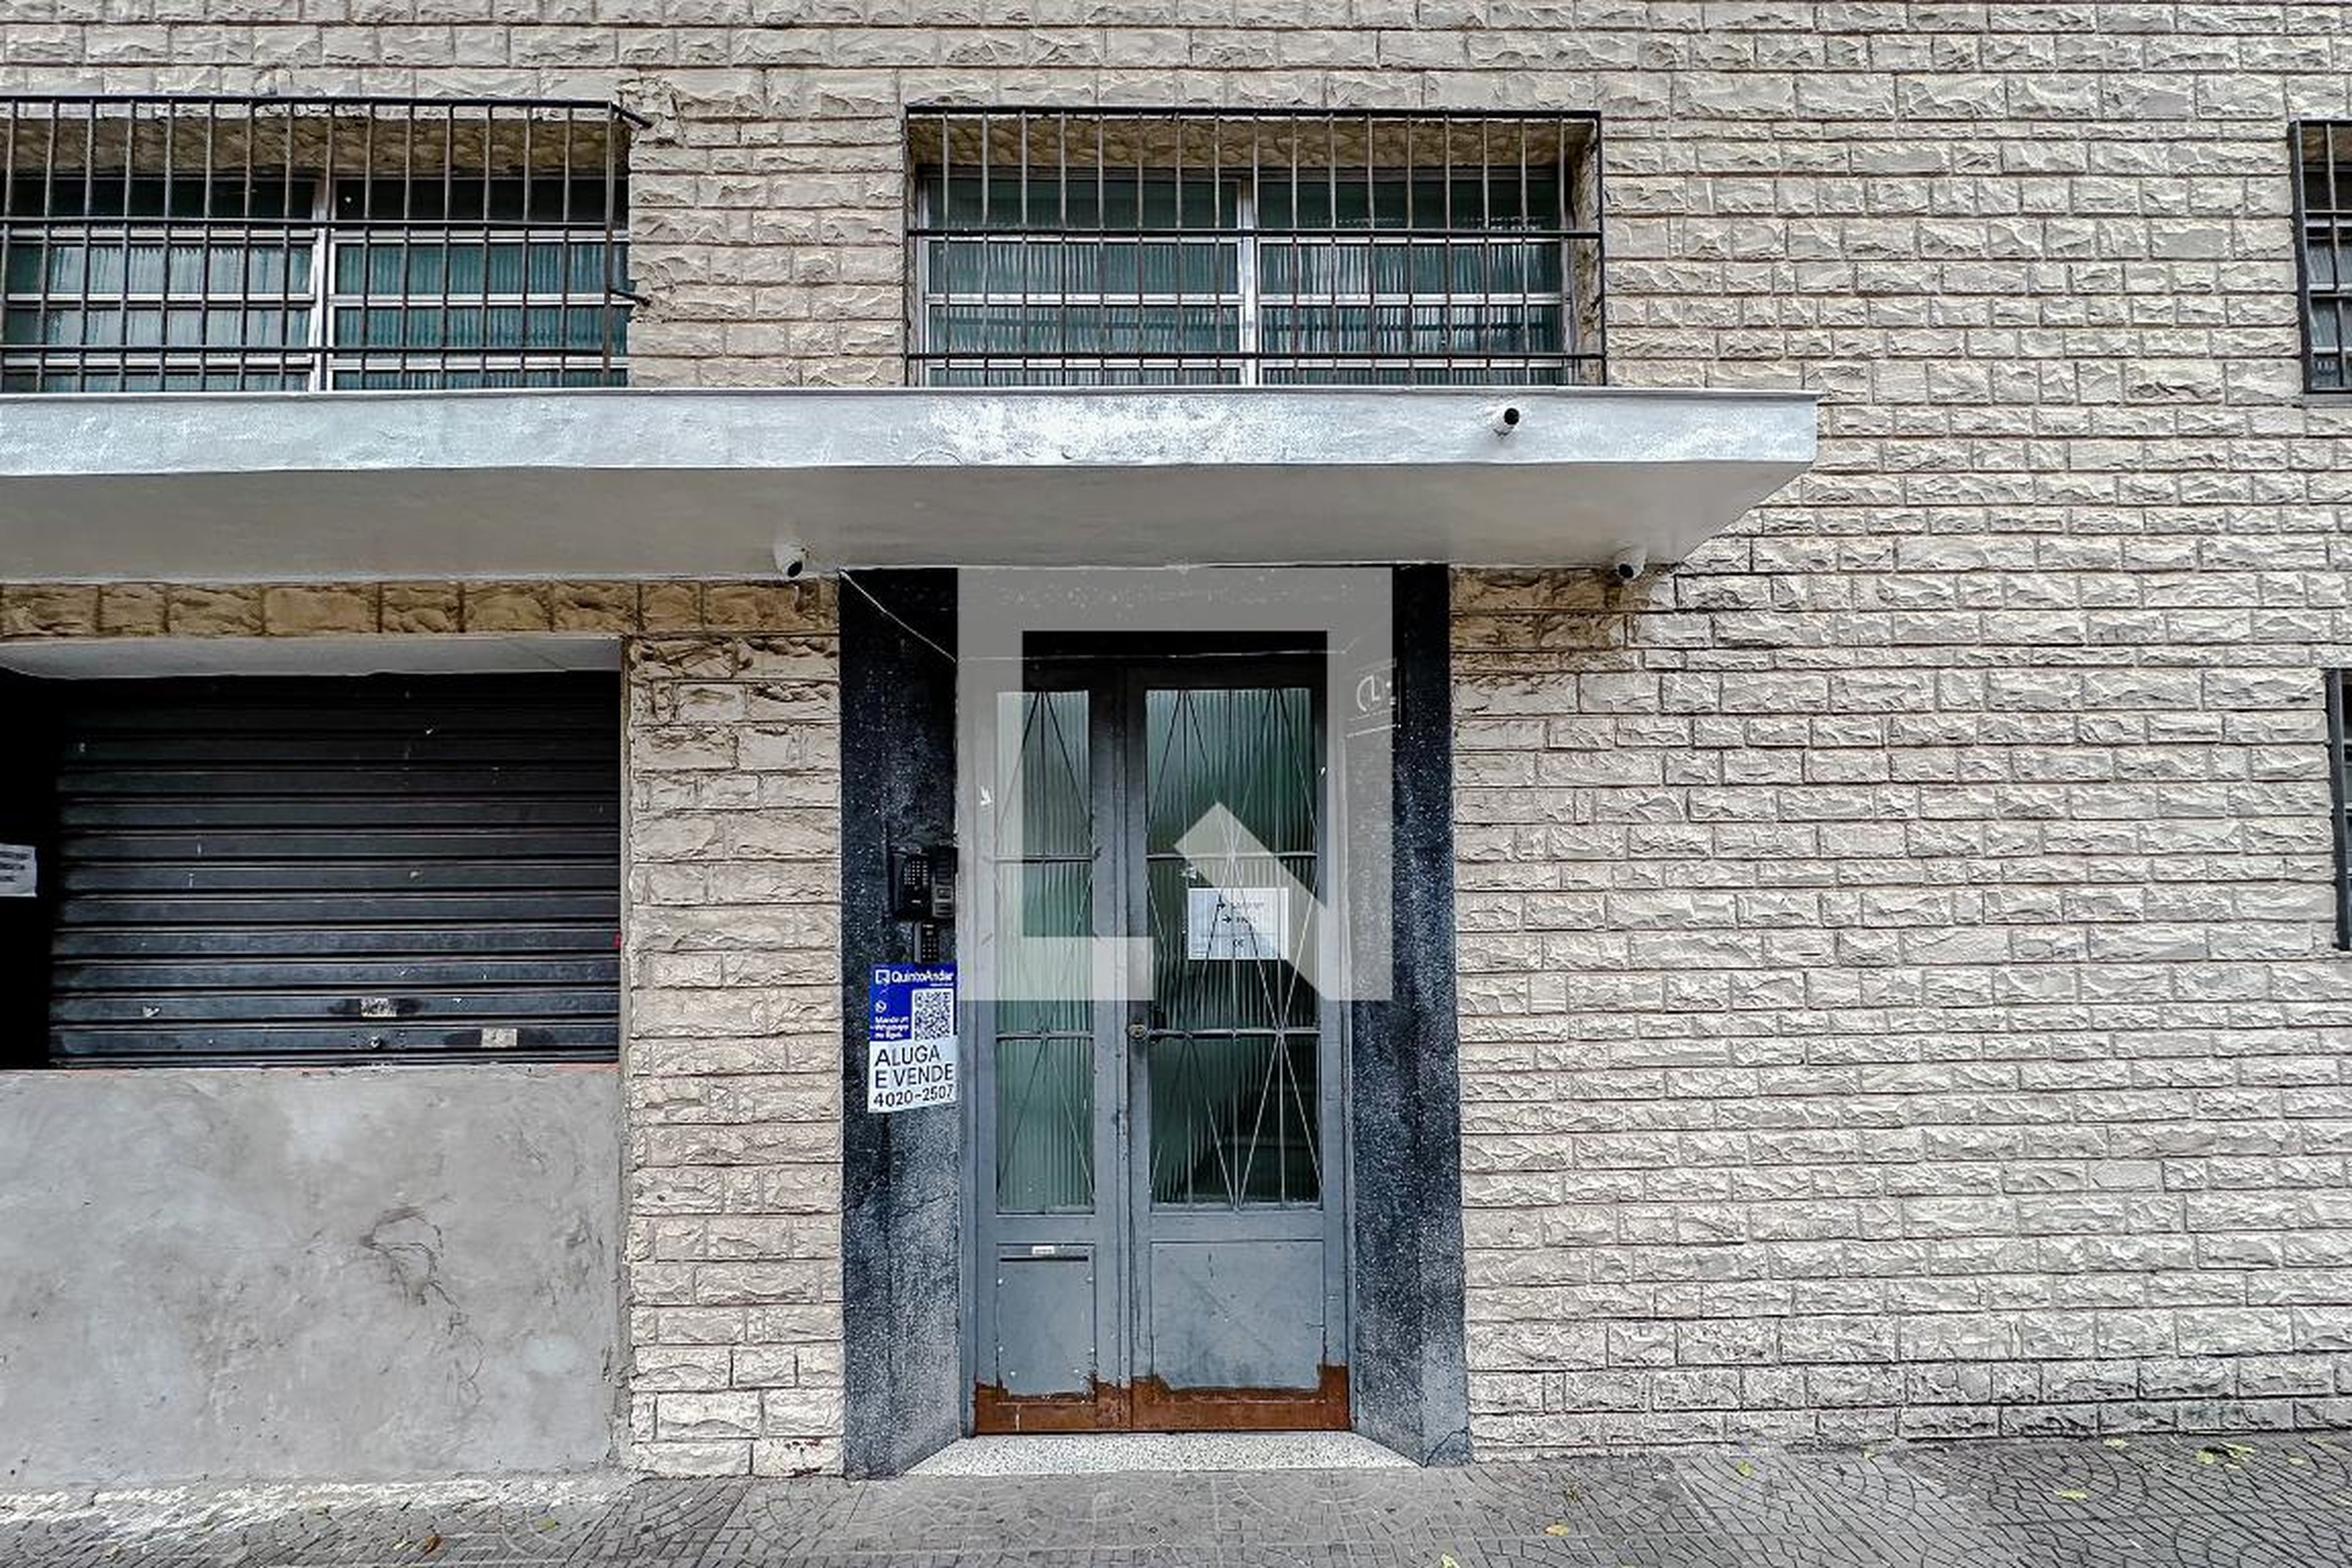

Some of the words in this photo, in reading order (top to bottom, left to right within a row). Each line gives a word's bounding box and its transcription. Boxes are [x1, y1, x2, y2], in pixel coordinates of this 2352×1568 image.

[892, 970, 954, 983] QuintoAndar
[875, 1044, 941, 1066] ALUGA
[875, 1069, 888, 1088] E
[893, 1063, 954, 1087] VENDE
[873, 1084, 954, 1107] 4020-2507
